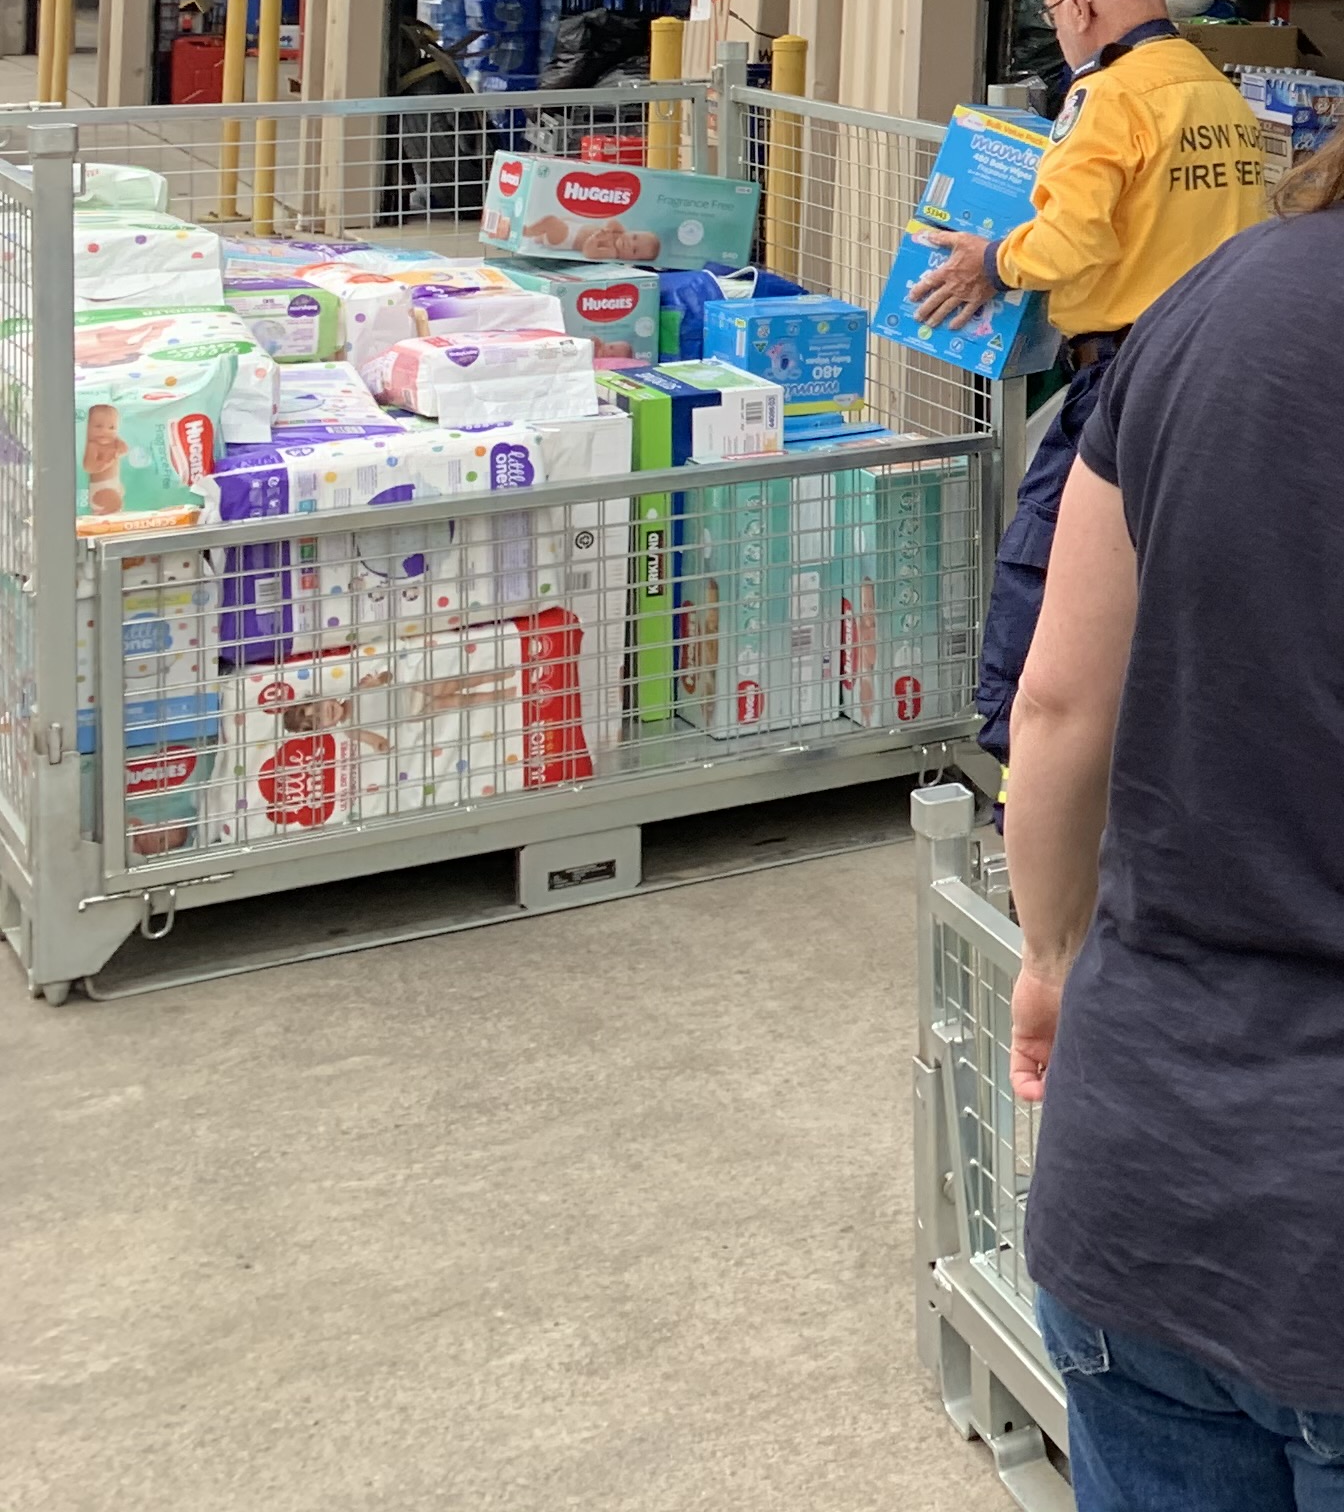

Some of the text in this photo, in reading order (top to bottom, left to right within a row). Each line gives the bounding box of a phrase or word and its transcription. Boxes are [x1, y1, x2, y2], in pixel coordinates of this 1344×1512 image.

[1180, 124, 1231, 152] NSW
[1169, 162, 1229, 192] FIRE
[563, 181, 632, 206] HUGGIES
[657, 194, 736, 211] Fragrance Free
[582, 297, 633, 312] HUGGIES
[812, 365, 843, 380] 480
